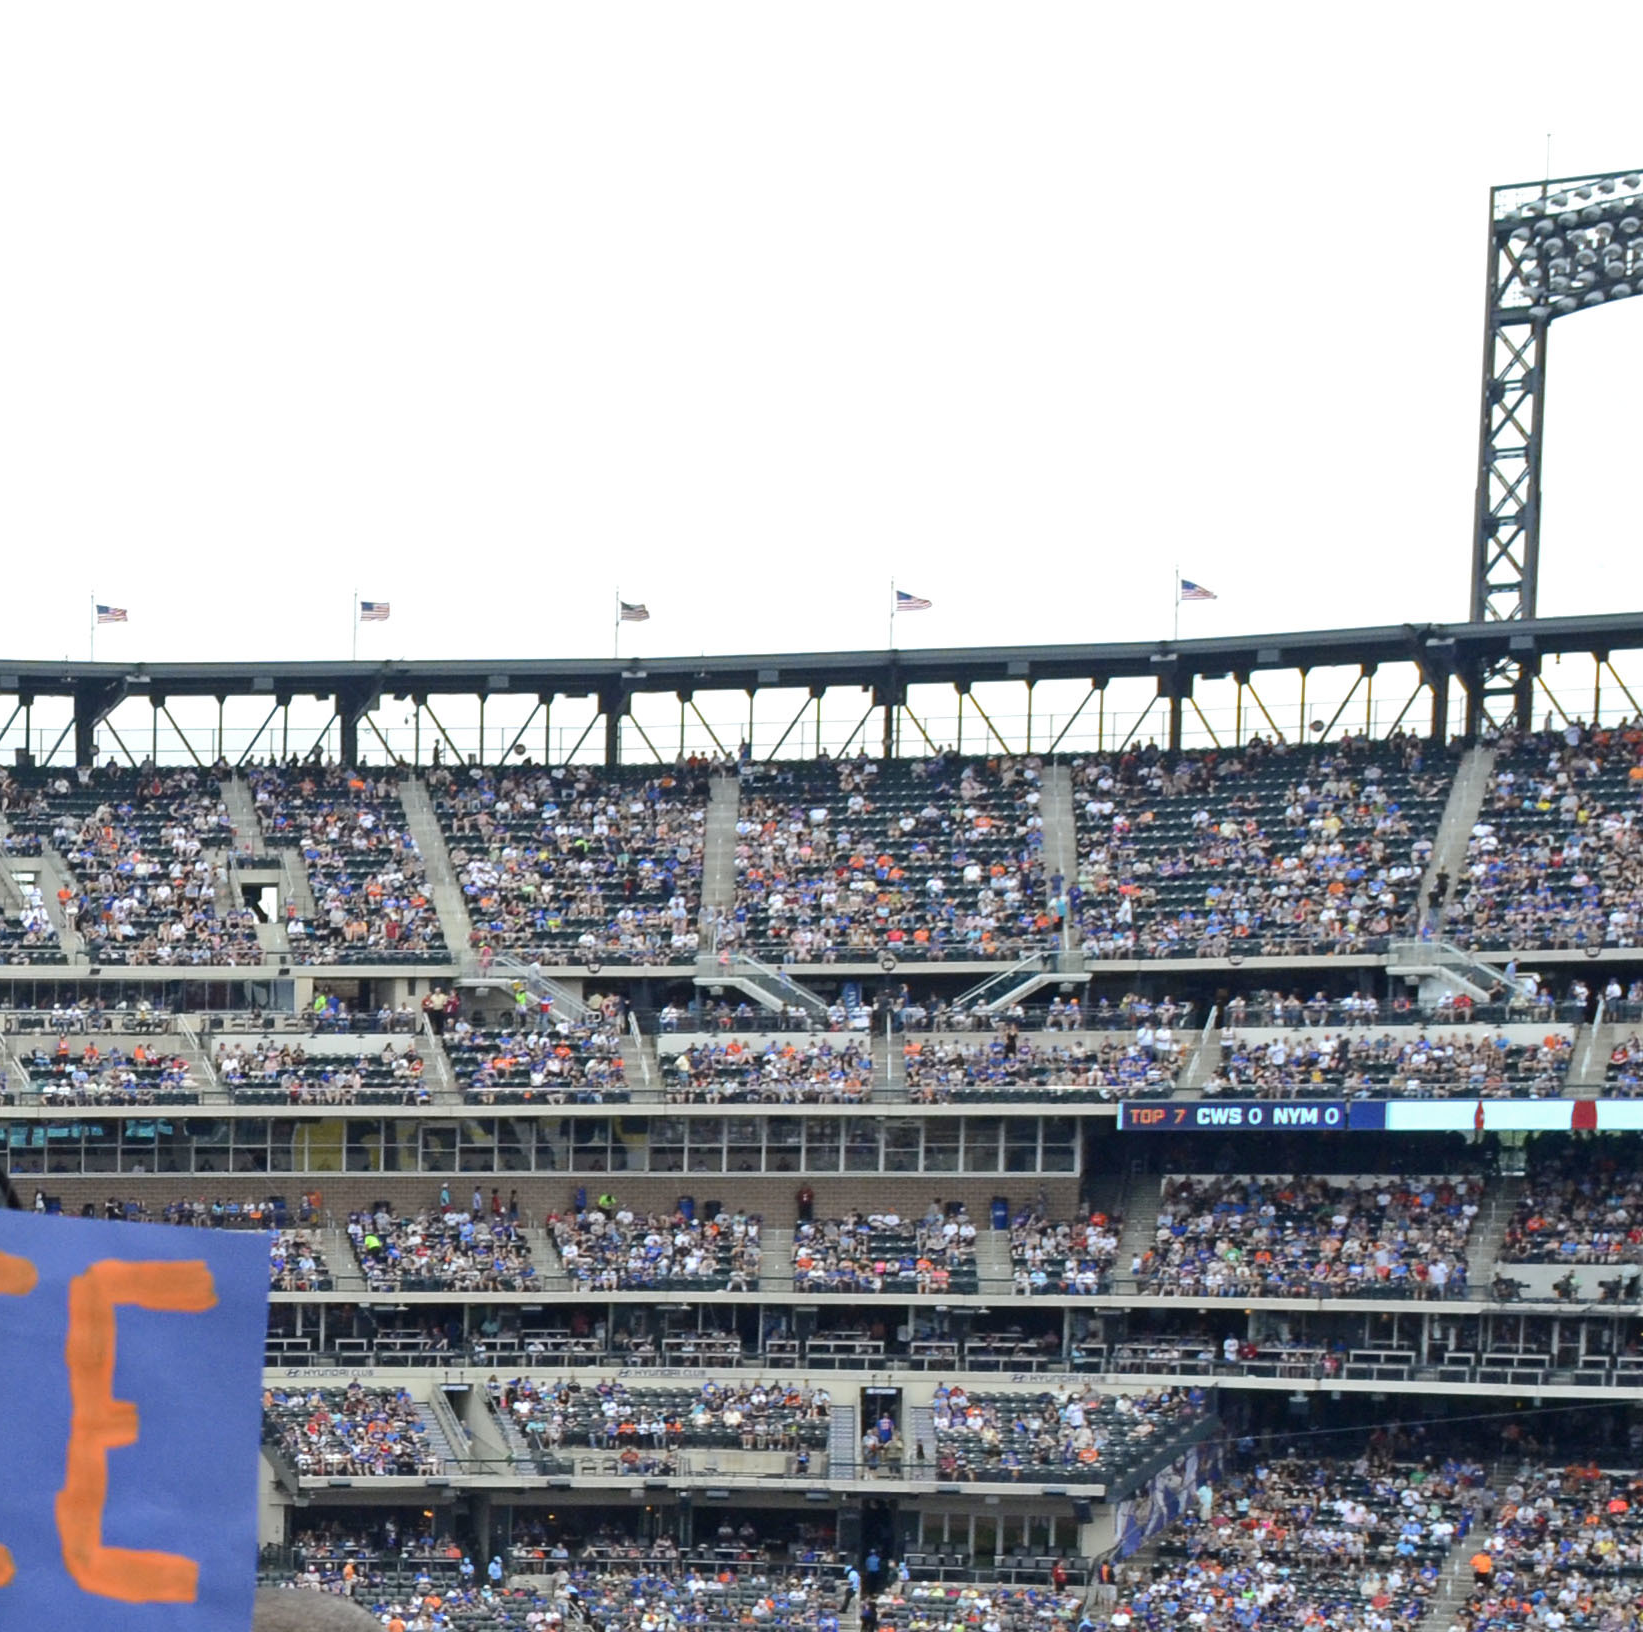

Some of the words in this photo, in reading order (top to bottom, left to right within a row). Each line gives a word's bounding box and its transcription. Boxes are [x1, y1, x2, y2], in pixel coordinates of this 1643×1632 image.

[1130, 1109, 1166, 1124] TOP
[1174, 1109, 1186, 1124] 7
[1196, 1107, 1242, 1125] CWS
[1248, 1108, 1263, 1125] 0
[1273, 1108, 1318, 1125] NYM
[1325, 1108, 1340, 1125] 0
